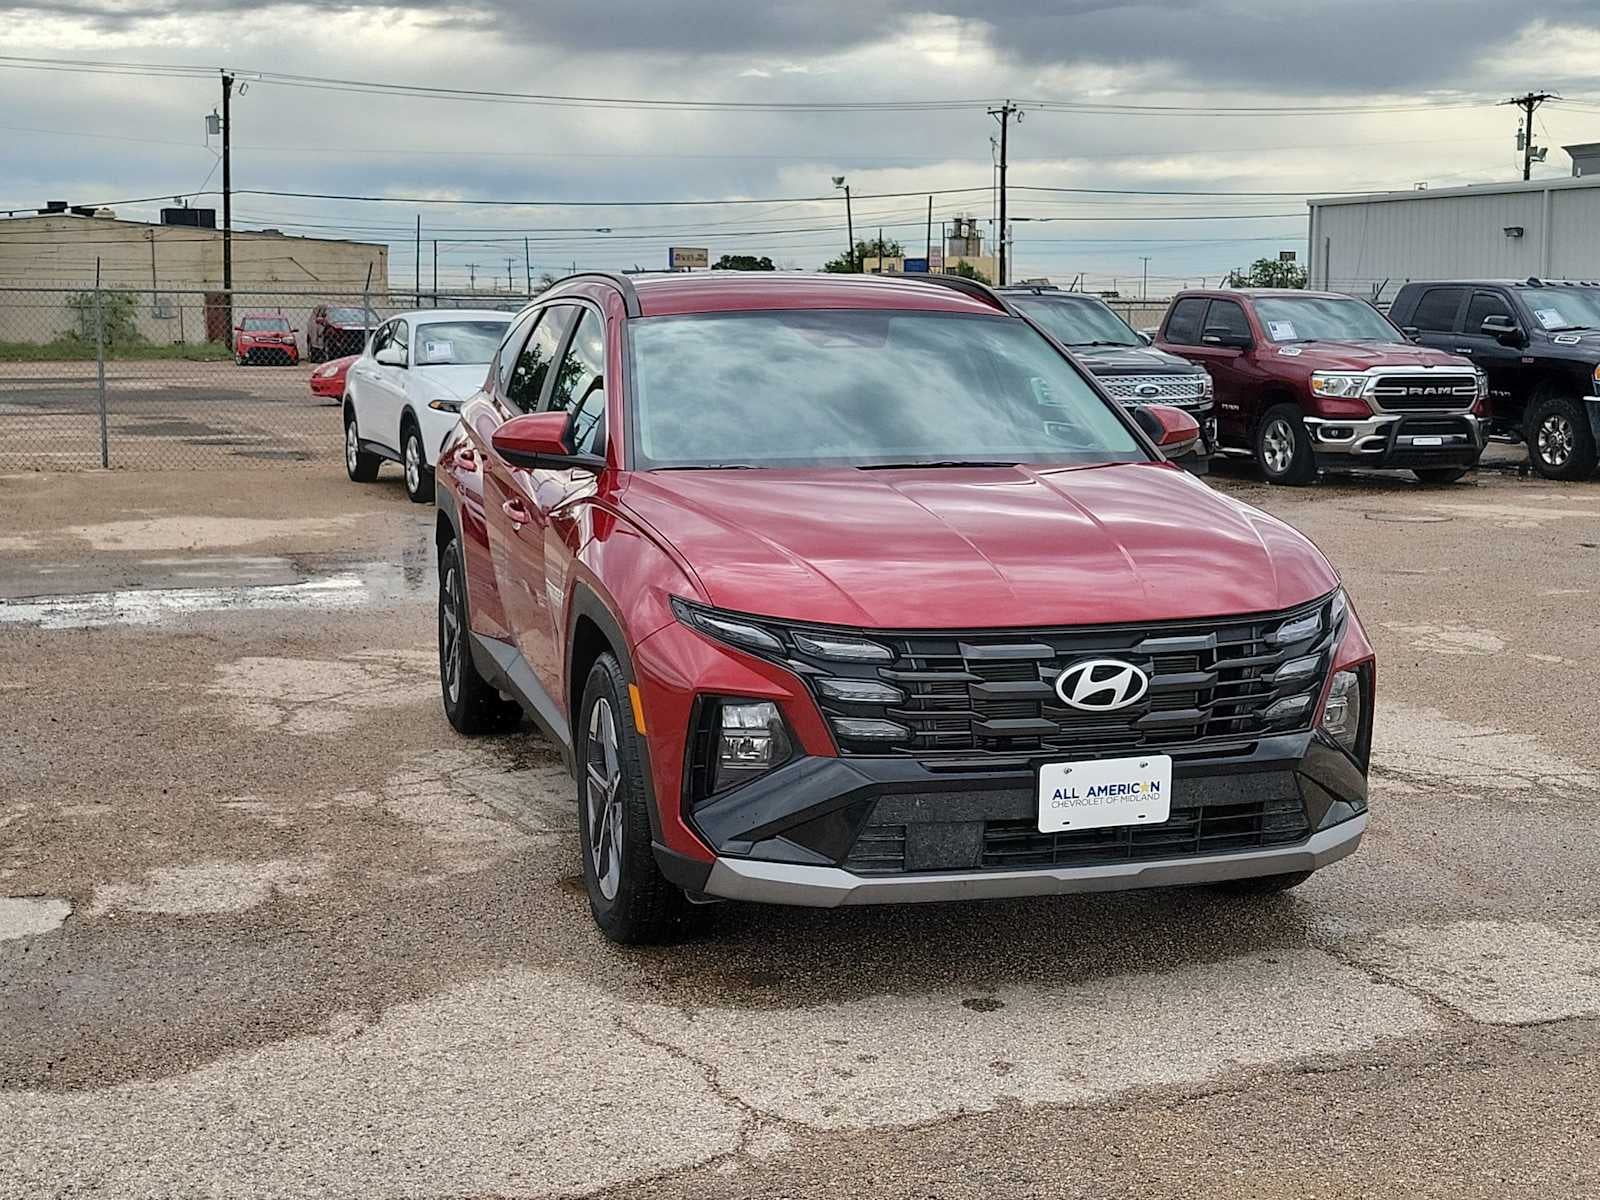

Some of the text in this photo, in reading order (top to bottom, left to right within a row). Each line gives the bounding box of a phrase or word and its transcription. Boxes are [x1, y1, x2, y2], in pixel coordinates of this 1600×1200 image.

[1409, 387, 1451, 395] RAM
[1052, 781, 1160, 800] ALL AMERICN
[1051, 792, 1160, 808] CHEVROLET OF MIDLAND
